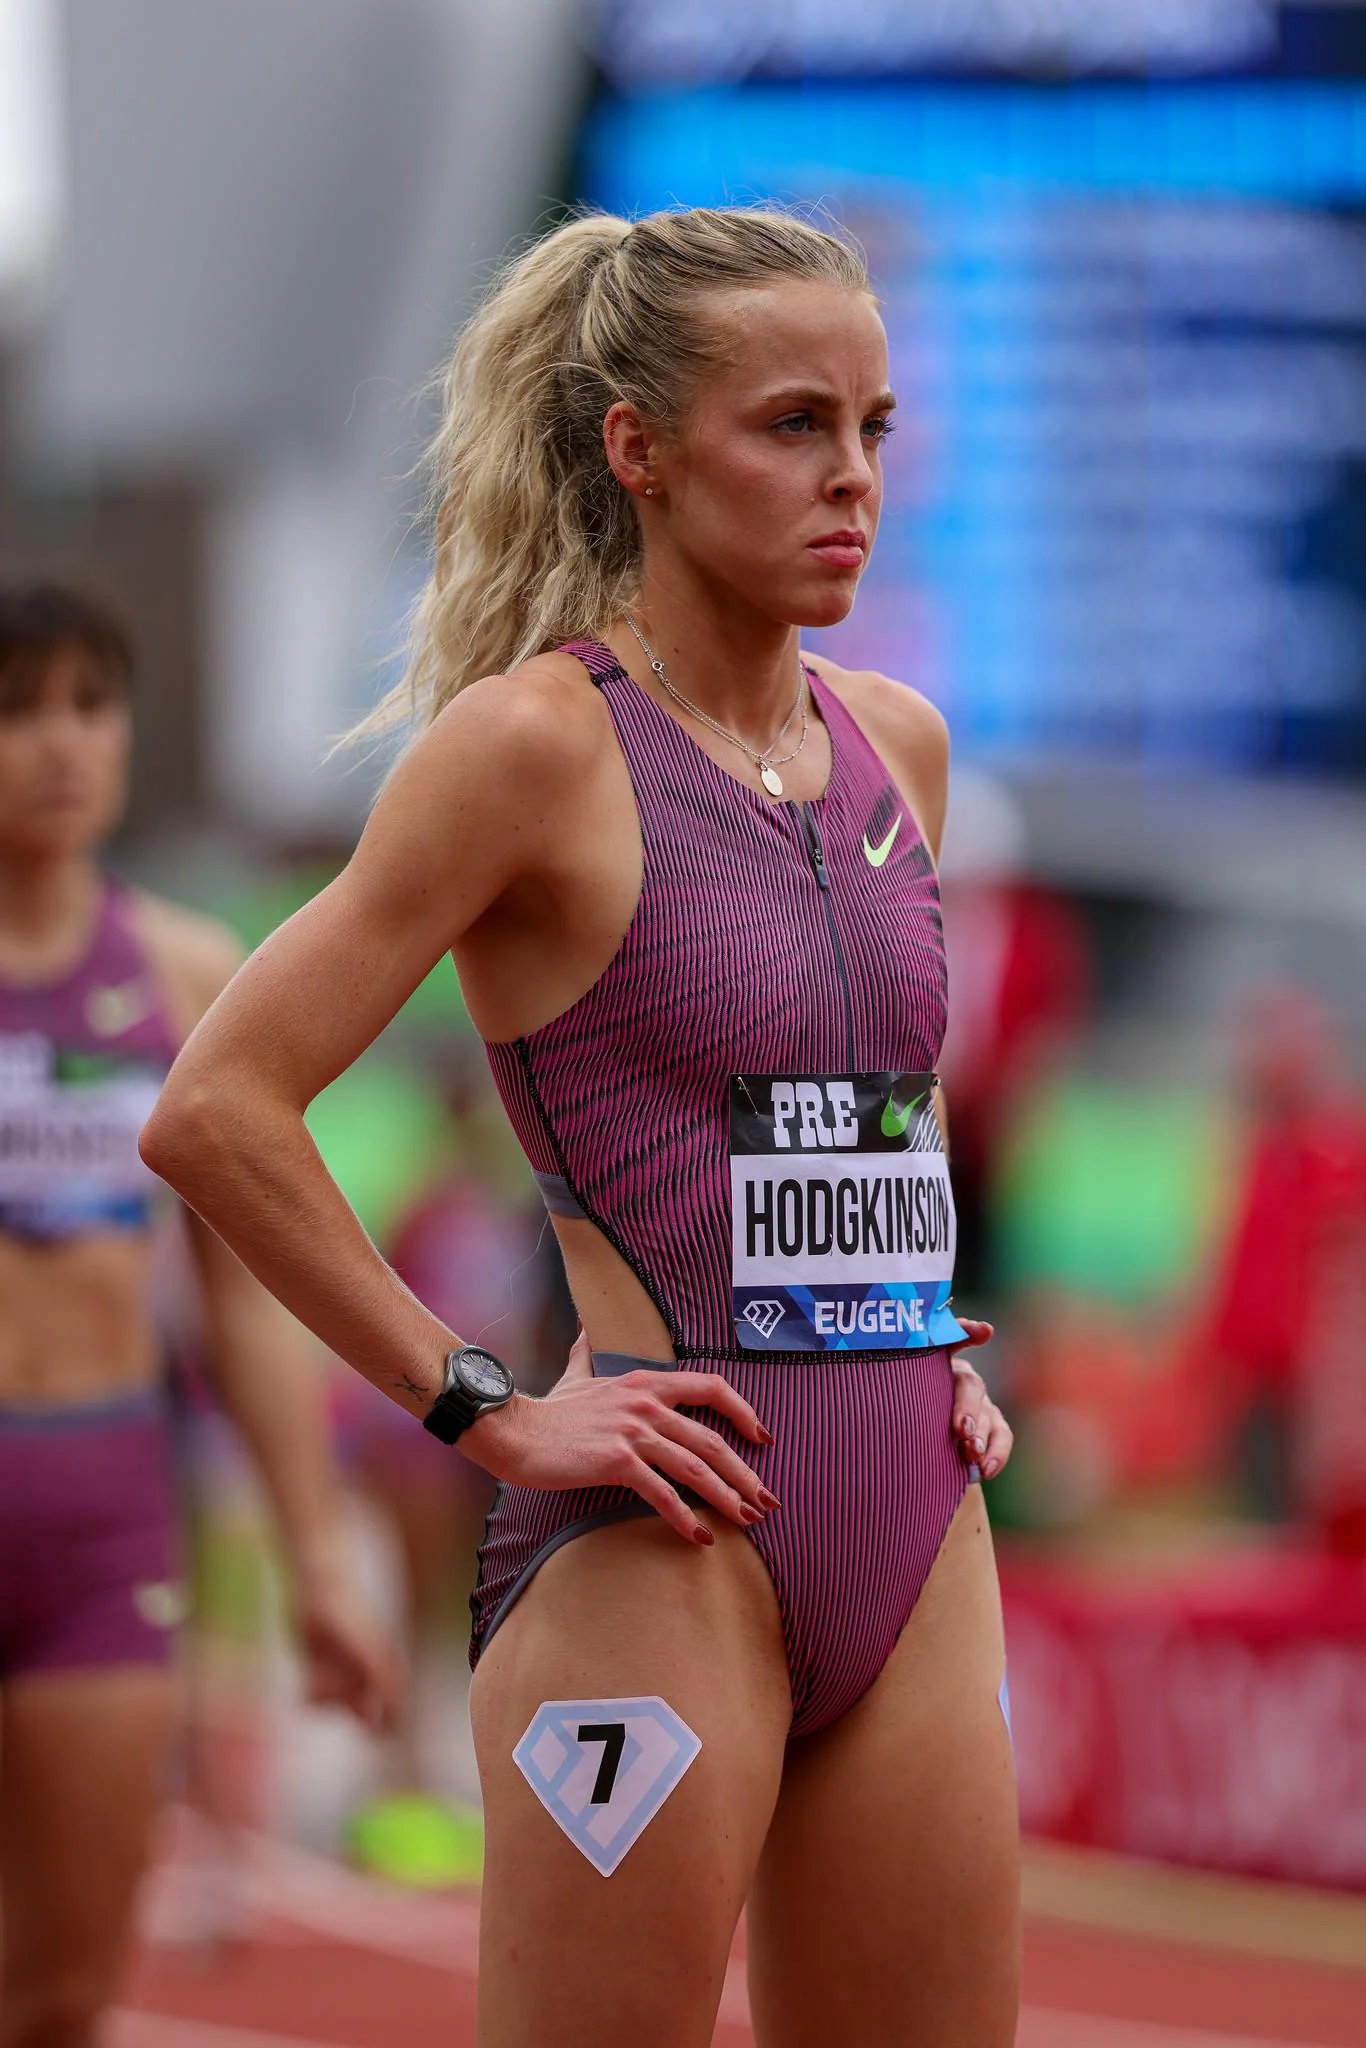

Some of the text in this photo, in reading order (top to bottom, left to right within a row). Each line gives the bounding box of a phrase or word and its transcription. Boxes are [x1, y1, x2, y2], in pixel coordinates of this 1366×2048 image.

[771, 1081, 859, 1148] PRE
[745, 1176, 949, 1258] HODGKINSON
[814, 1298, 924, 1335] EUGENE
[577, 1723, 626, 1805] 7
